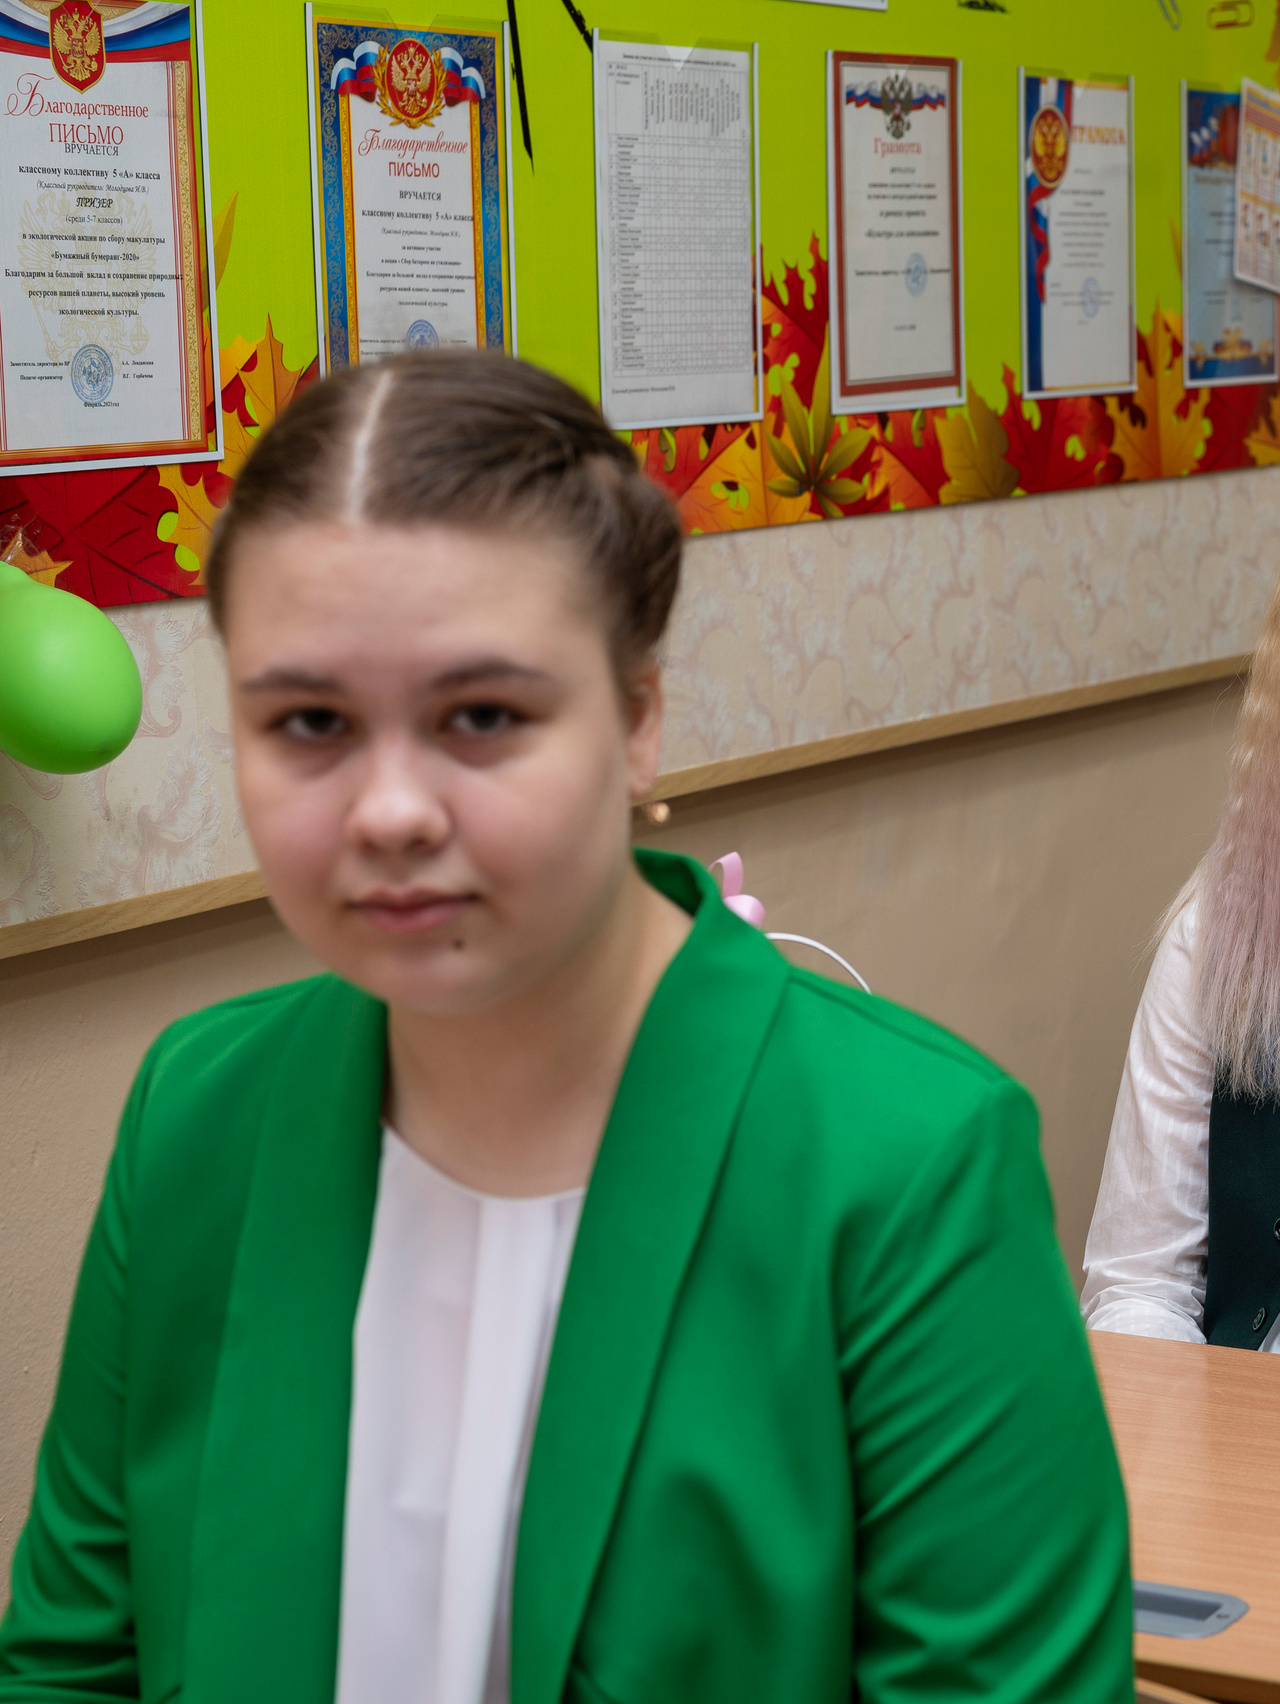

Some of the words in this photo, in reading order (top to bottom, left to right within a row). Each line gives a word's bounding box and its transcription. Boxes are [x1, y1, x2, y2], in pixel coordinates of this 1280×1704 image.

[3, 72, 149, 119] Благодарственное
[49, 123, 124, 145] ПИСЬМО
[64, 143, 119, 156] ВРУЧАЕТСЯ
[358, 128, 468, 159] Благодарственное
[873, 137, 922, 158] Грамота
[19, 165, 62, 177] классному
[64, 168, 109, 180] коллективу
[112, 168, 117, 178] 5
[135, 171, 161, 180] класса
[388, 161, 440, 178] ПИСЬМО
[399, 190, 442, 201] ВРУЧАЕТСЯ
[76, 197, 113, 209] ПРИЗЕР
[65, 214, 86, 224] (среди
[87, 215, 96, 223] 5-7
[97, 216, 123, 225] классов)
[361, 209, 395, 220] классному
[396, 211, 432, 222] коллективу
[435, 211, 439, 220] 5
[453, 214, 474, 222] класса
[28, 233, 76, 241] экологической
[107, 235, 125, 244] сбору
[126, 237, 165, 245] макулатуры
[5, 269, 46, 279] Благодарим
[55, 270, 84, 279] большой
[28, 290, 58, 298] ресурсов
[59, 289, 80, 297] нашей
[112, 289, 139, 298] высокий
[140, 291, 165, 299] уровень
[58, 308, 105, 316] экологической
